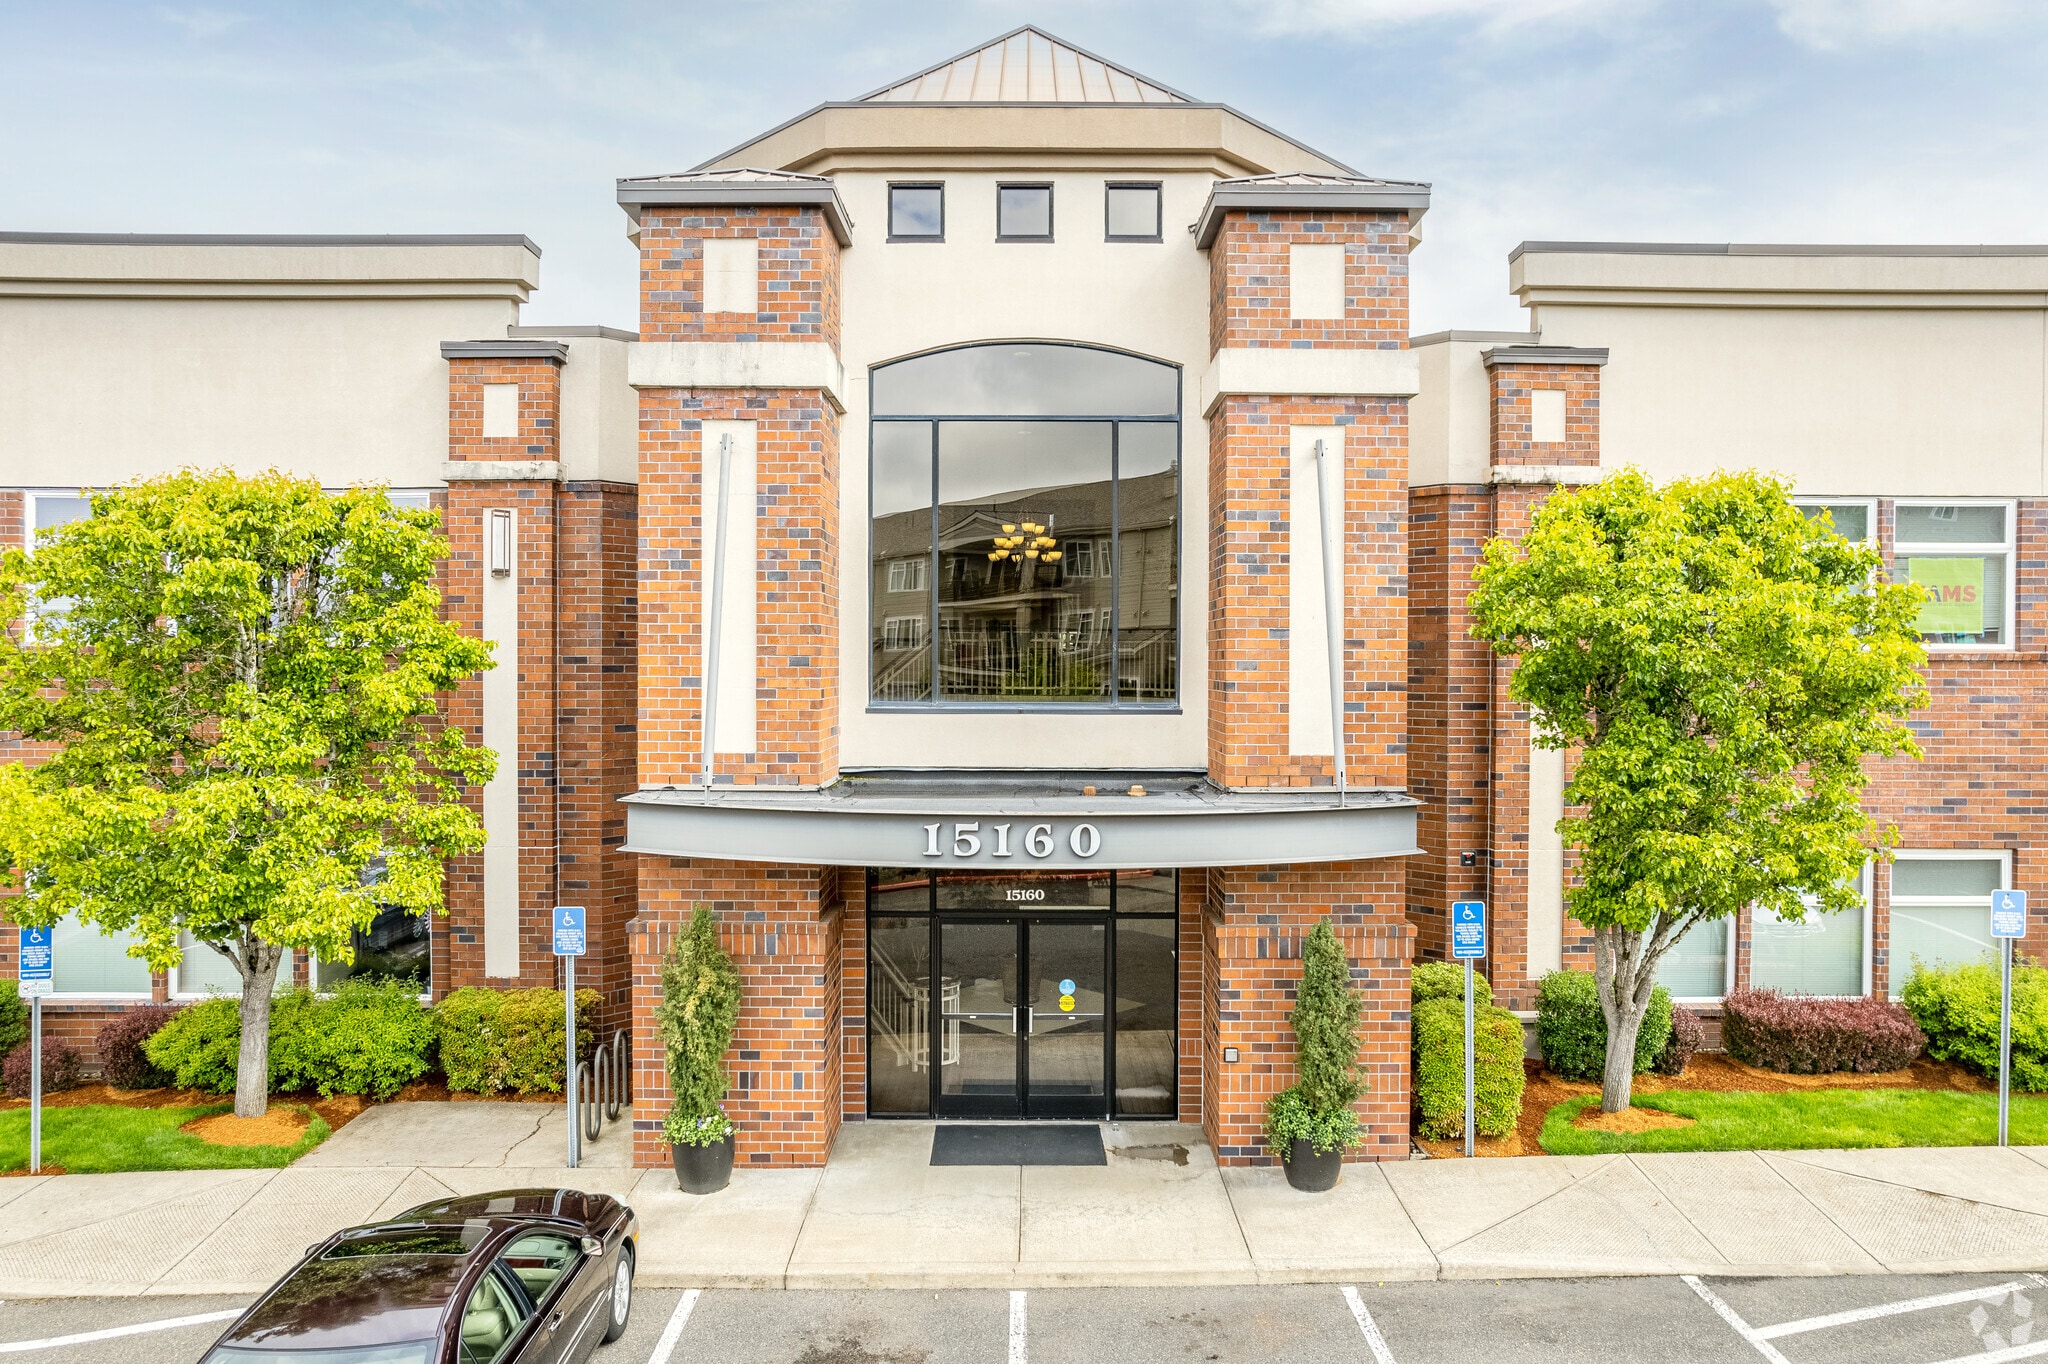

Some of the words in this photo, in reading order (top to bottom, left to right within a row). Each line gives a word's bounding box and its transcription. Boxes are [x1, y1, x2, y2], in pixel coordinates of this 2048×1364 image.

[1921, 585, 1977, 602] AMS
[922, 821, 1101, 858] 15160
[1005, 889, 1045, 901] 15160
